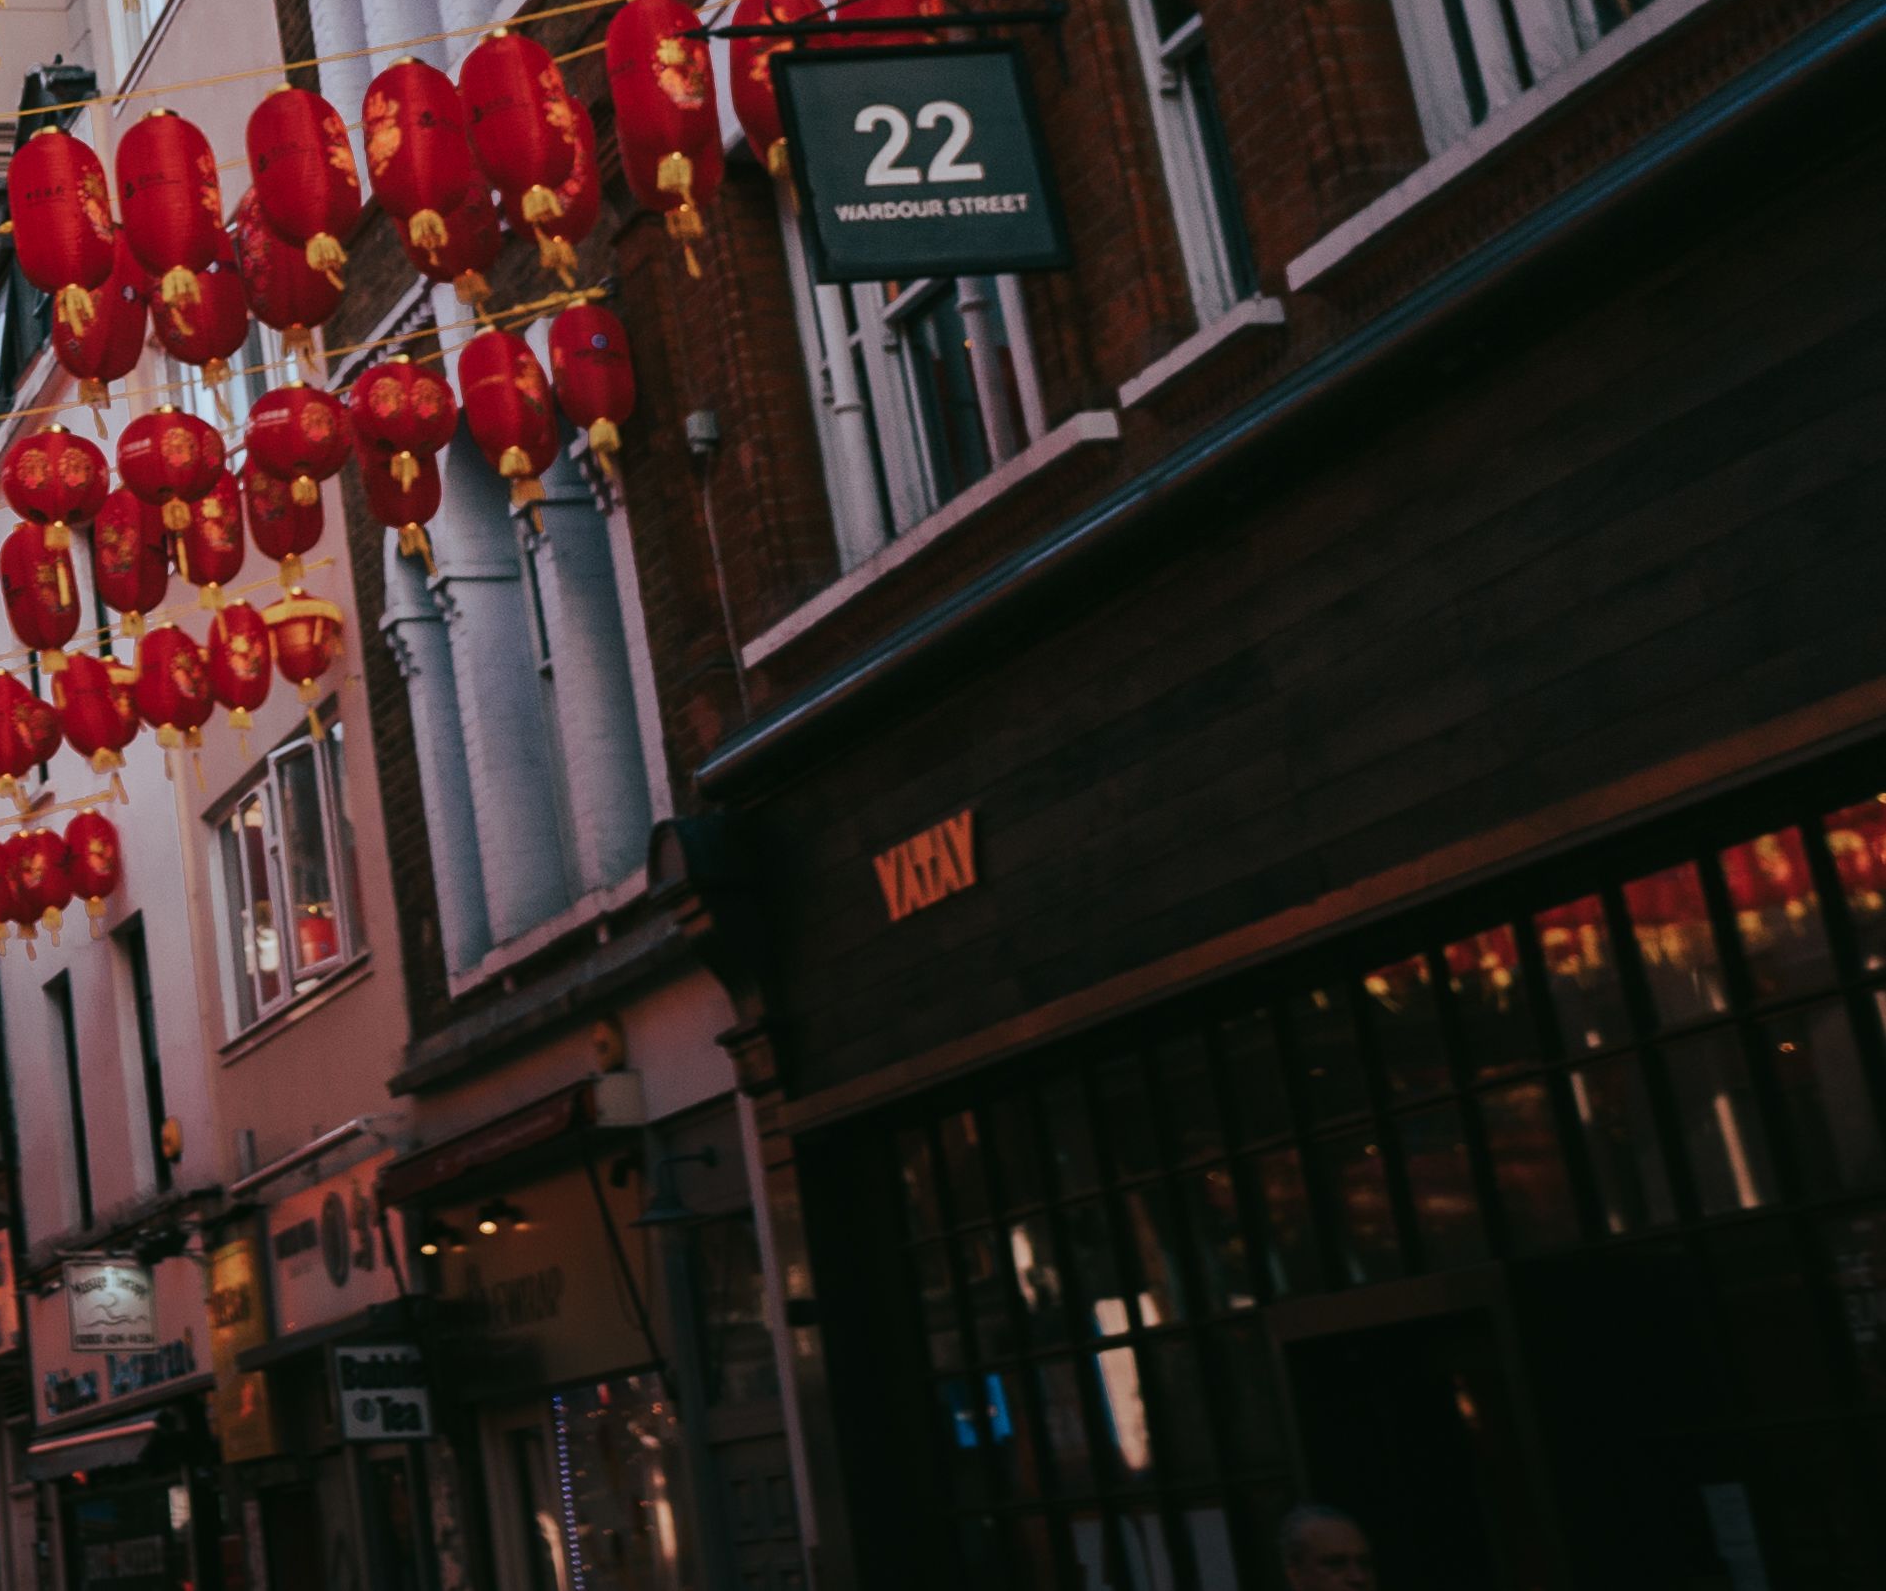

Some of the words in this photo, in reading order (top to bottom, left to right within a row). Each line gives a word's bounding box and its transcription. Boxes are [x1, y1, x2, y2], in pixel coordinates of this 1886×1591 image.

[855, 100, 985, 186] 22
[835, 199, 945, 222] WARDOUR
[948, 193, 1028, 216] STREET
[872, 808, 978, 921] YATAY
